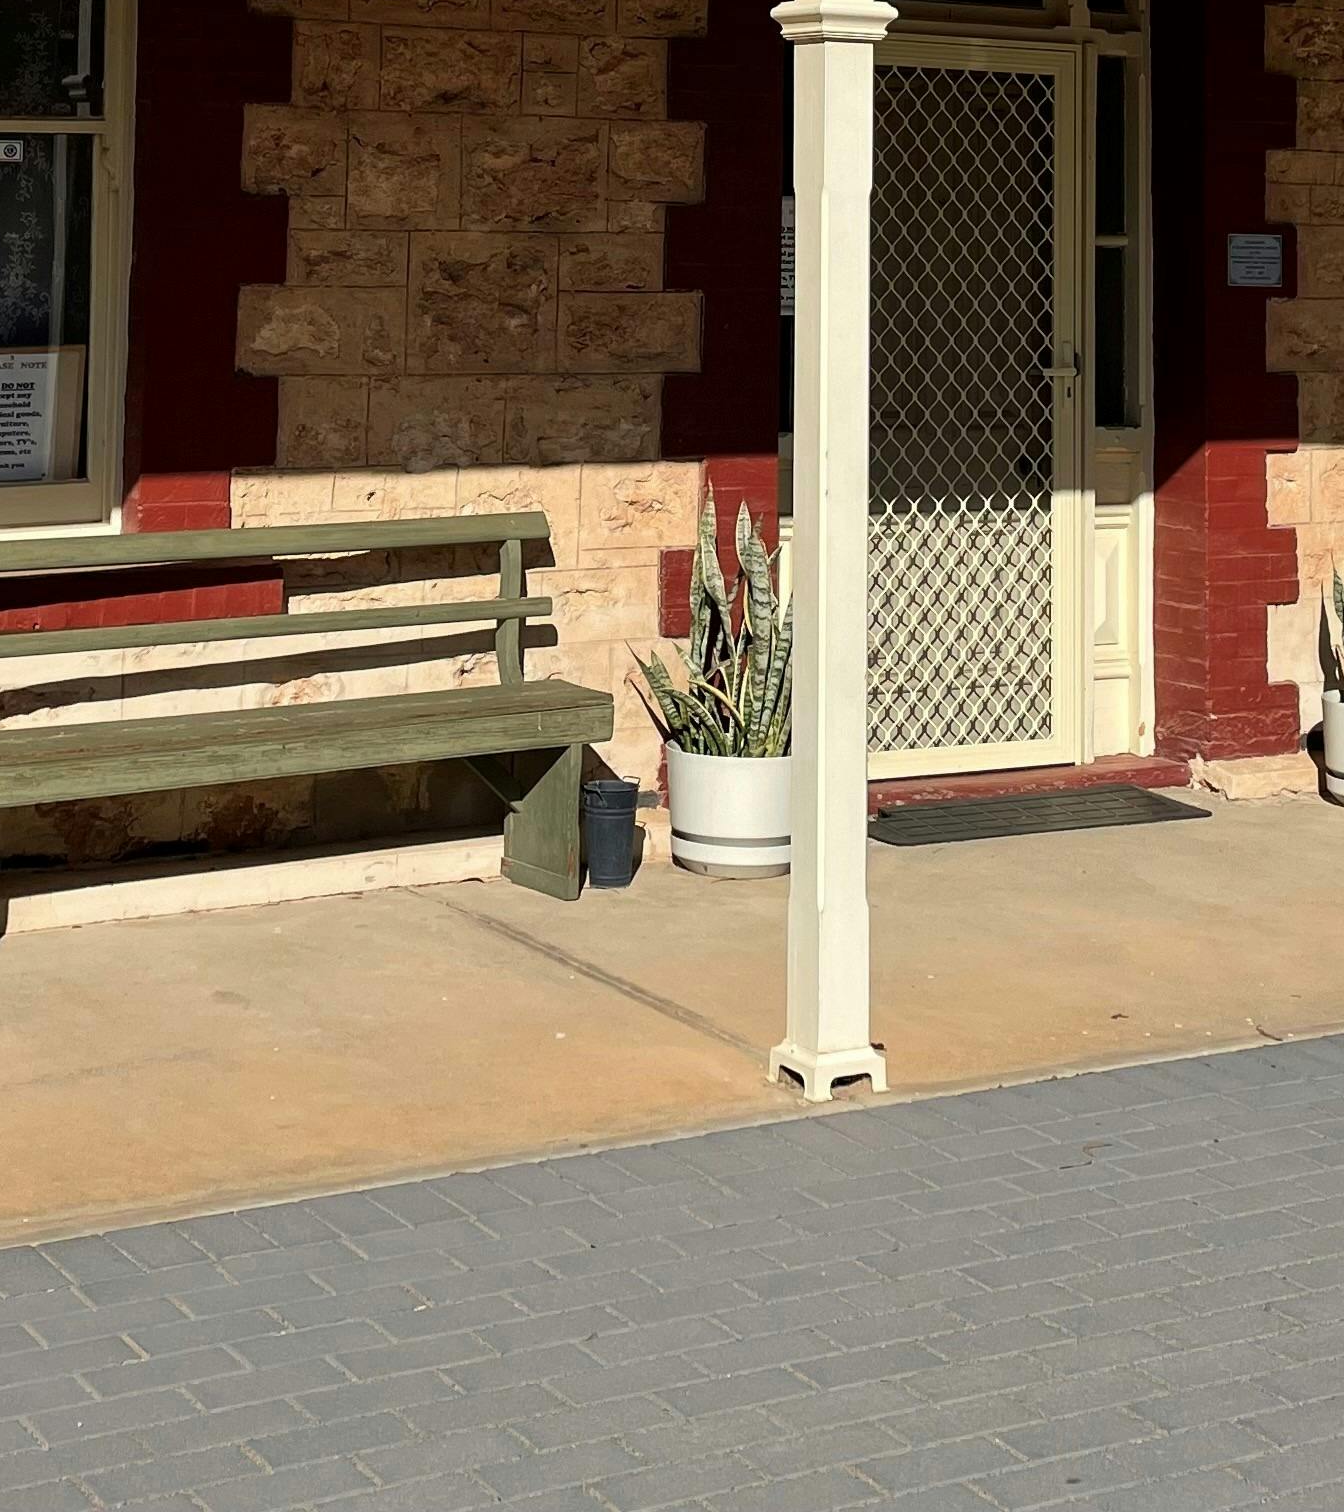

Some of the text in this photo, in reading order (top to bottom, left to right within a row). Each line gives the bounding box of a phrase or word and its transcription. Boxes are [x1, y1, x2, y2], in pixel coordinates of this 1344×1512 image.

[21, 361, 47, 369] NOTE
[1, 382, 14, 391] DO
[16, 382, 35, 391] NOT
